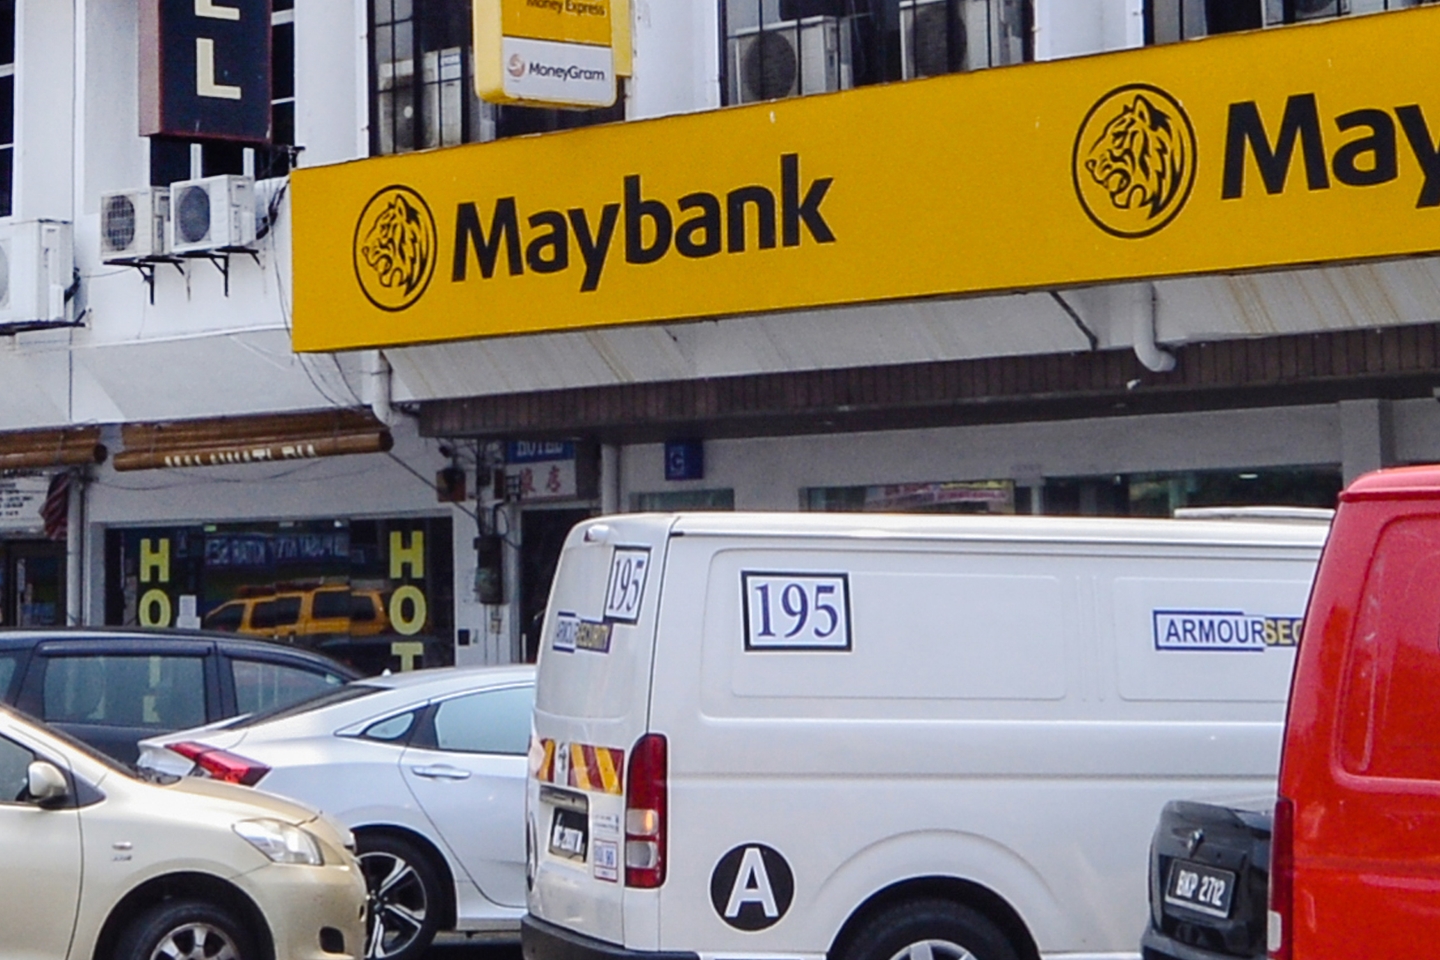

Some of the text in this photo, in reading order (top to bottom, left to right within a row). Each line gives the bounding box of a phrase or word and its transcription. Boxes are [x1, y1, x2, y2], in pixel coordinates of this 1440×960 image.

[528, 62, 606, 82] MoneyGram
[451, 152, 837, 293] Maybank
[608, 558, 645, 613] 195
[755, 583, 839, 638] 195
[724, 847, 780, 918] A
